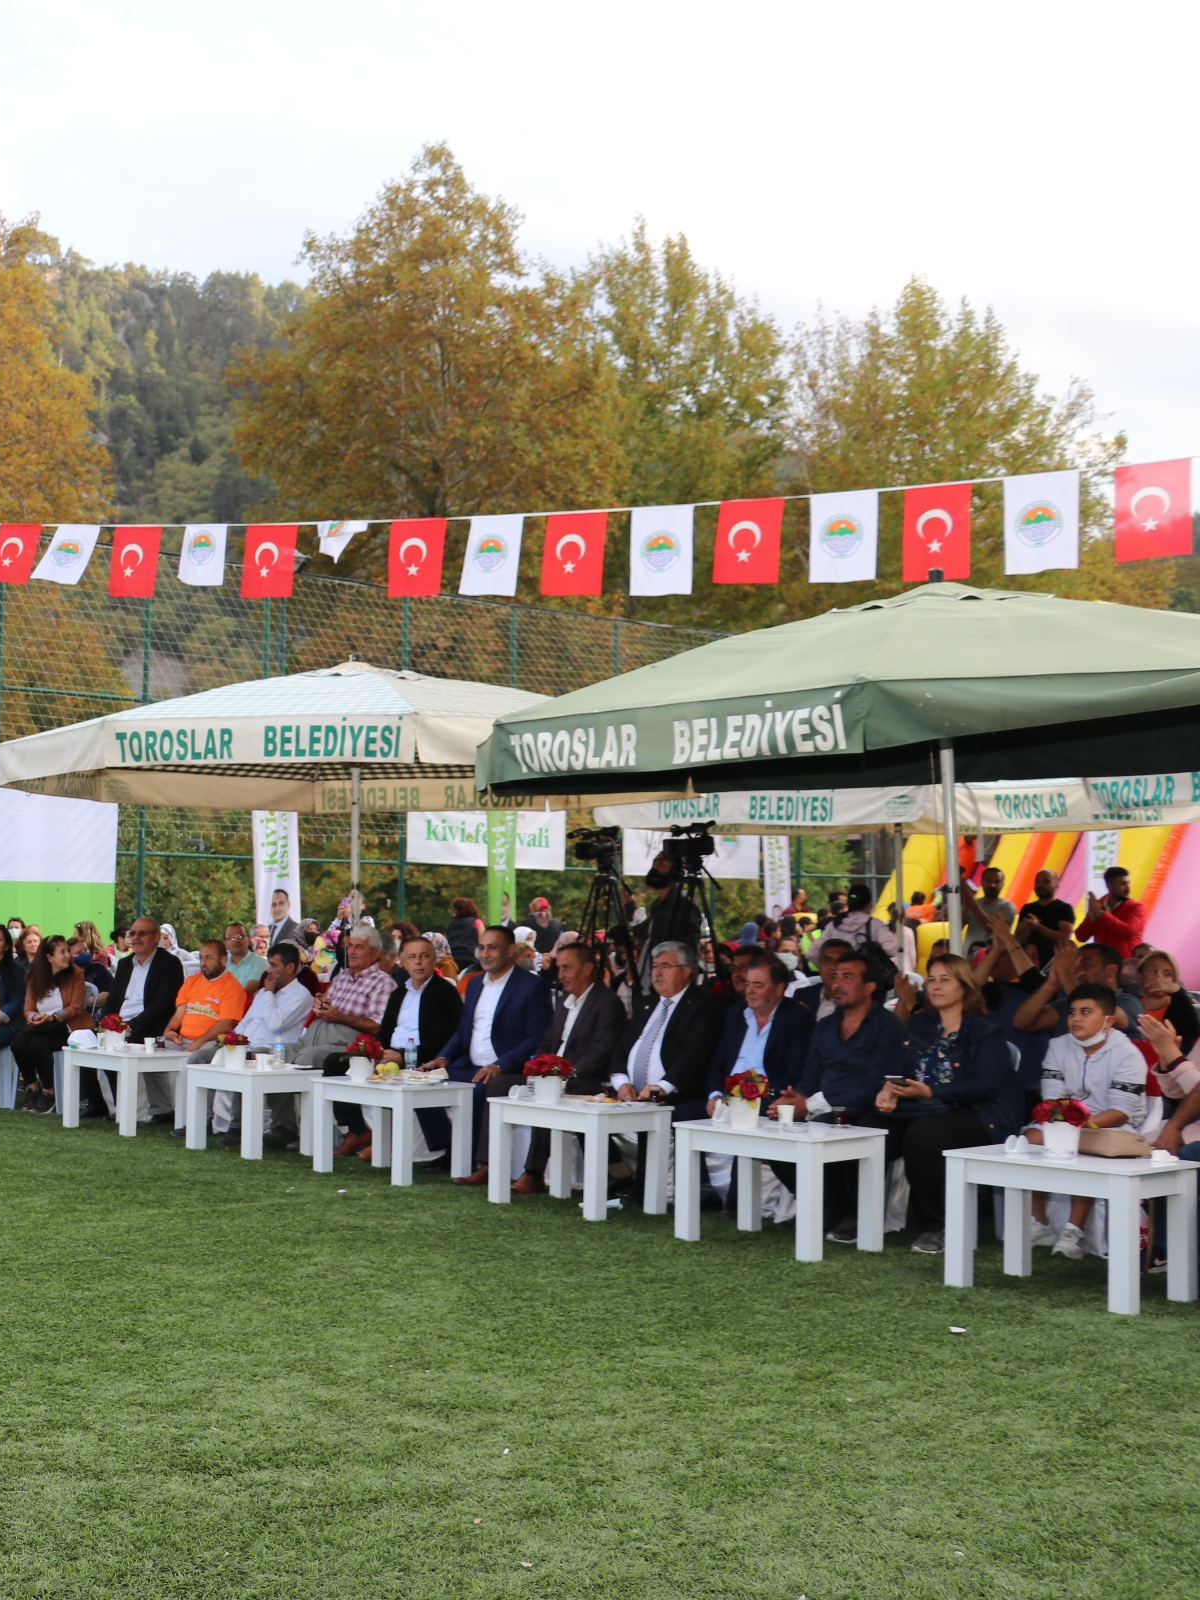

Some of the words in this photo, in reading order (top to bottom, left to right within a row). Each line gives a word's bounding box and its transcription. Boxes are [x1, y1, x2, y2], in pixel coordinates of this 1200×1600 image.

[115, 728, 233, 763] TOROSLAR
[263, 716, 403, 759] BELEDİYESİ
[509, 723, 638, 774] TOROSLAR
[672, 690, 847, 765] BELEDİYESİ
[658, 794, 720, 819] TOROSLAR
[749, 789, 835, 822] BELEDİYESİ
[994, 792, 1067, 819] TOROSLAR
[1091, 775, 1175, 811] TOROSLAR
[259, 817, 278, 867] kivi
[276, 811, 290, 879] festiva
[425, 818, 467, 843] kivi
[474, 822, 550, 849] fevali
